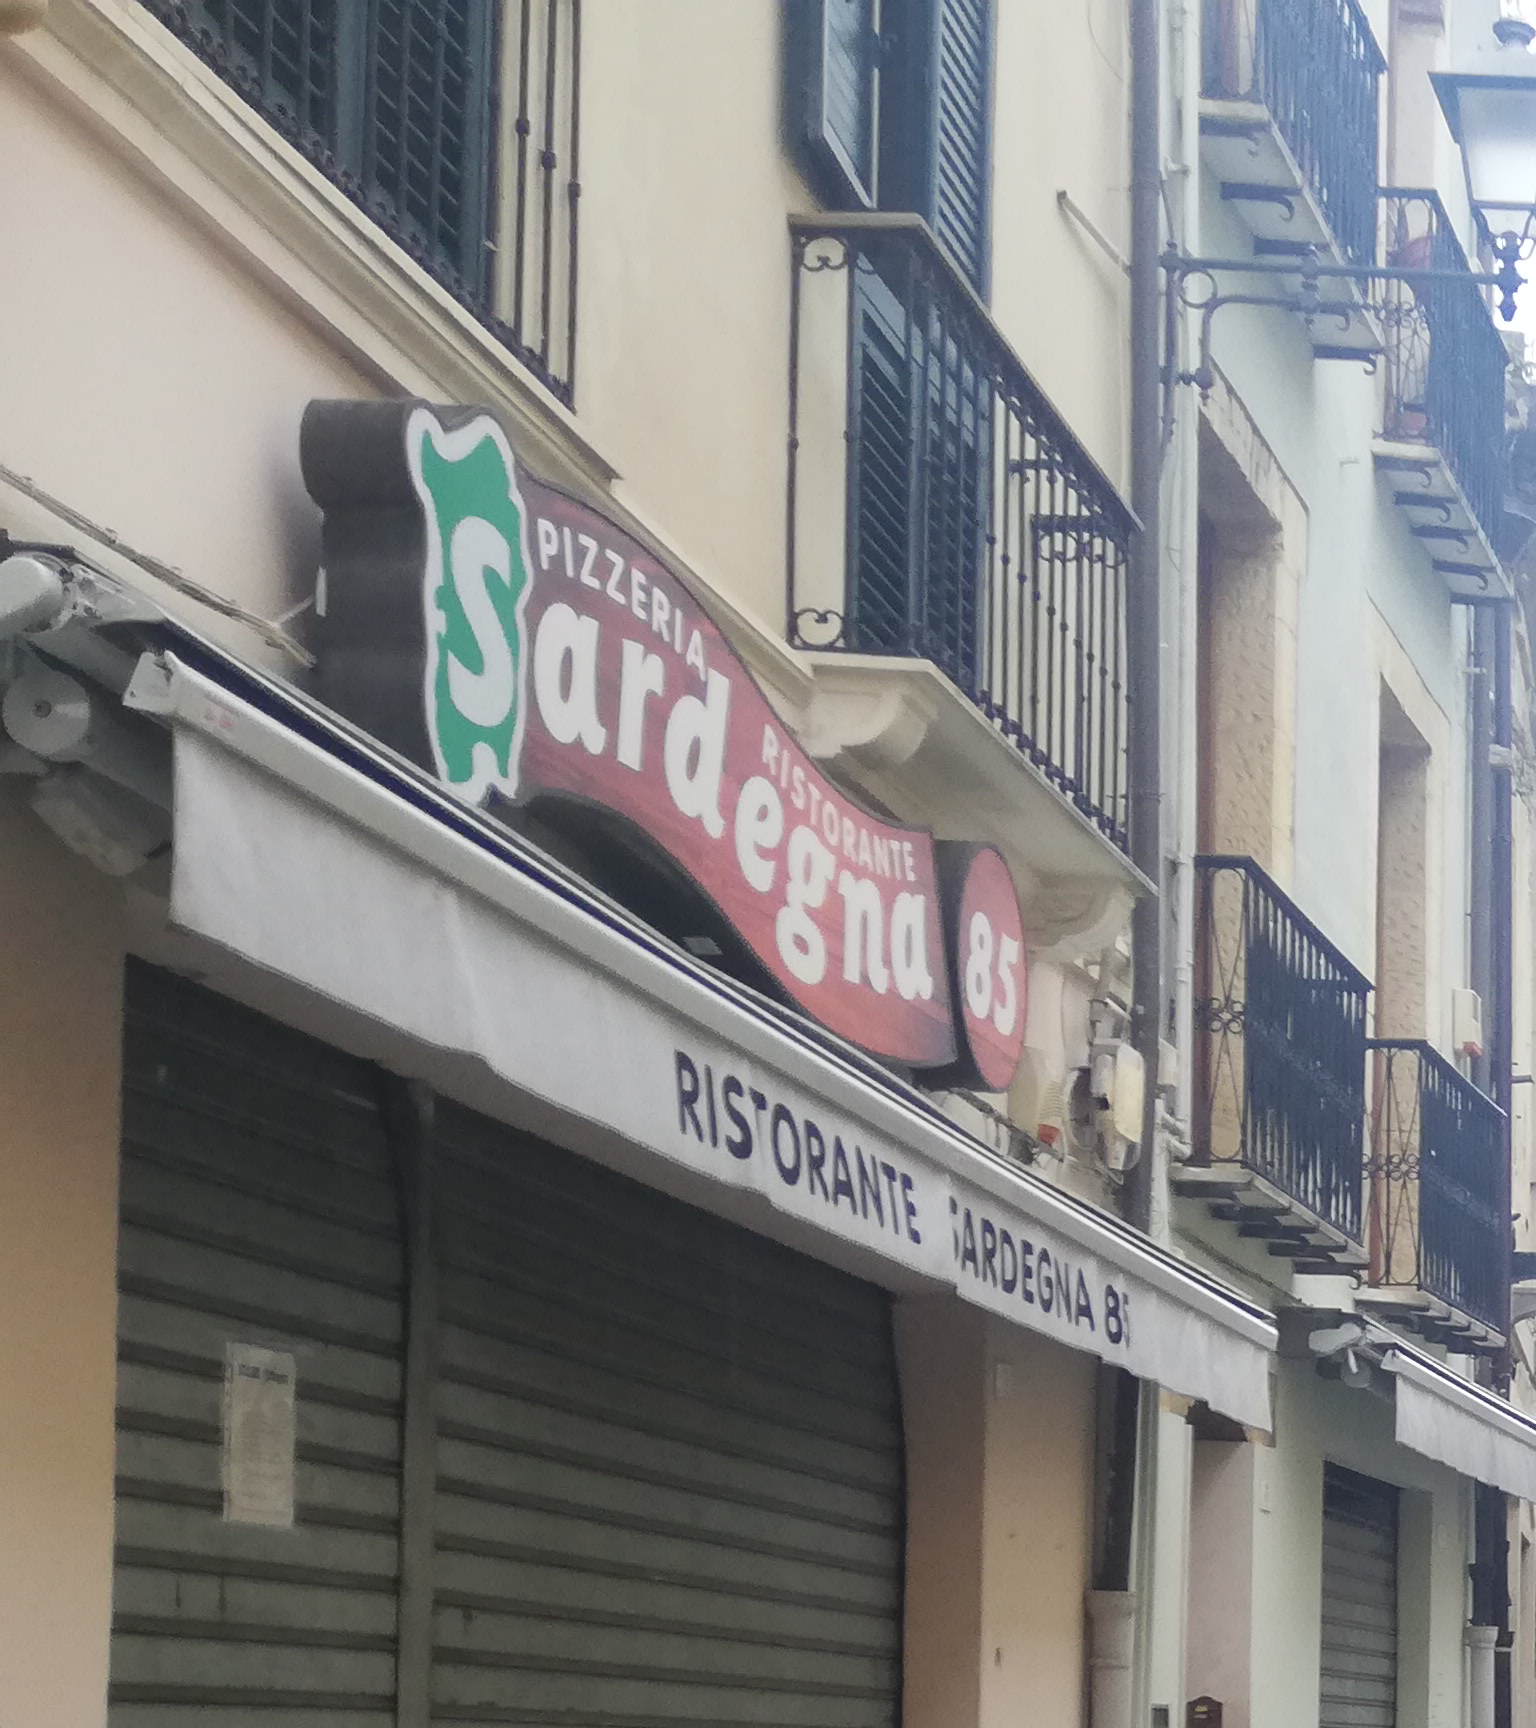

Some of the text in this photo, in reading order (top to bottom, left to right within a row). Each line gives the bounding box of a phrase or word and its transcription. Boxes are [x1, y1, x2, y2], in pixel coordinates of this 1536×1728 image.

[537, 517, 711, 682] PIZZERIA
[446, 516, 934, 1003] Sardegna
[762, 722, 916, 883] RISTORANTE
[965, 910, 1019, 1038] 85
[673, 1049, 922, 1245] RISTORANTE
